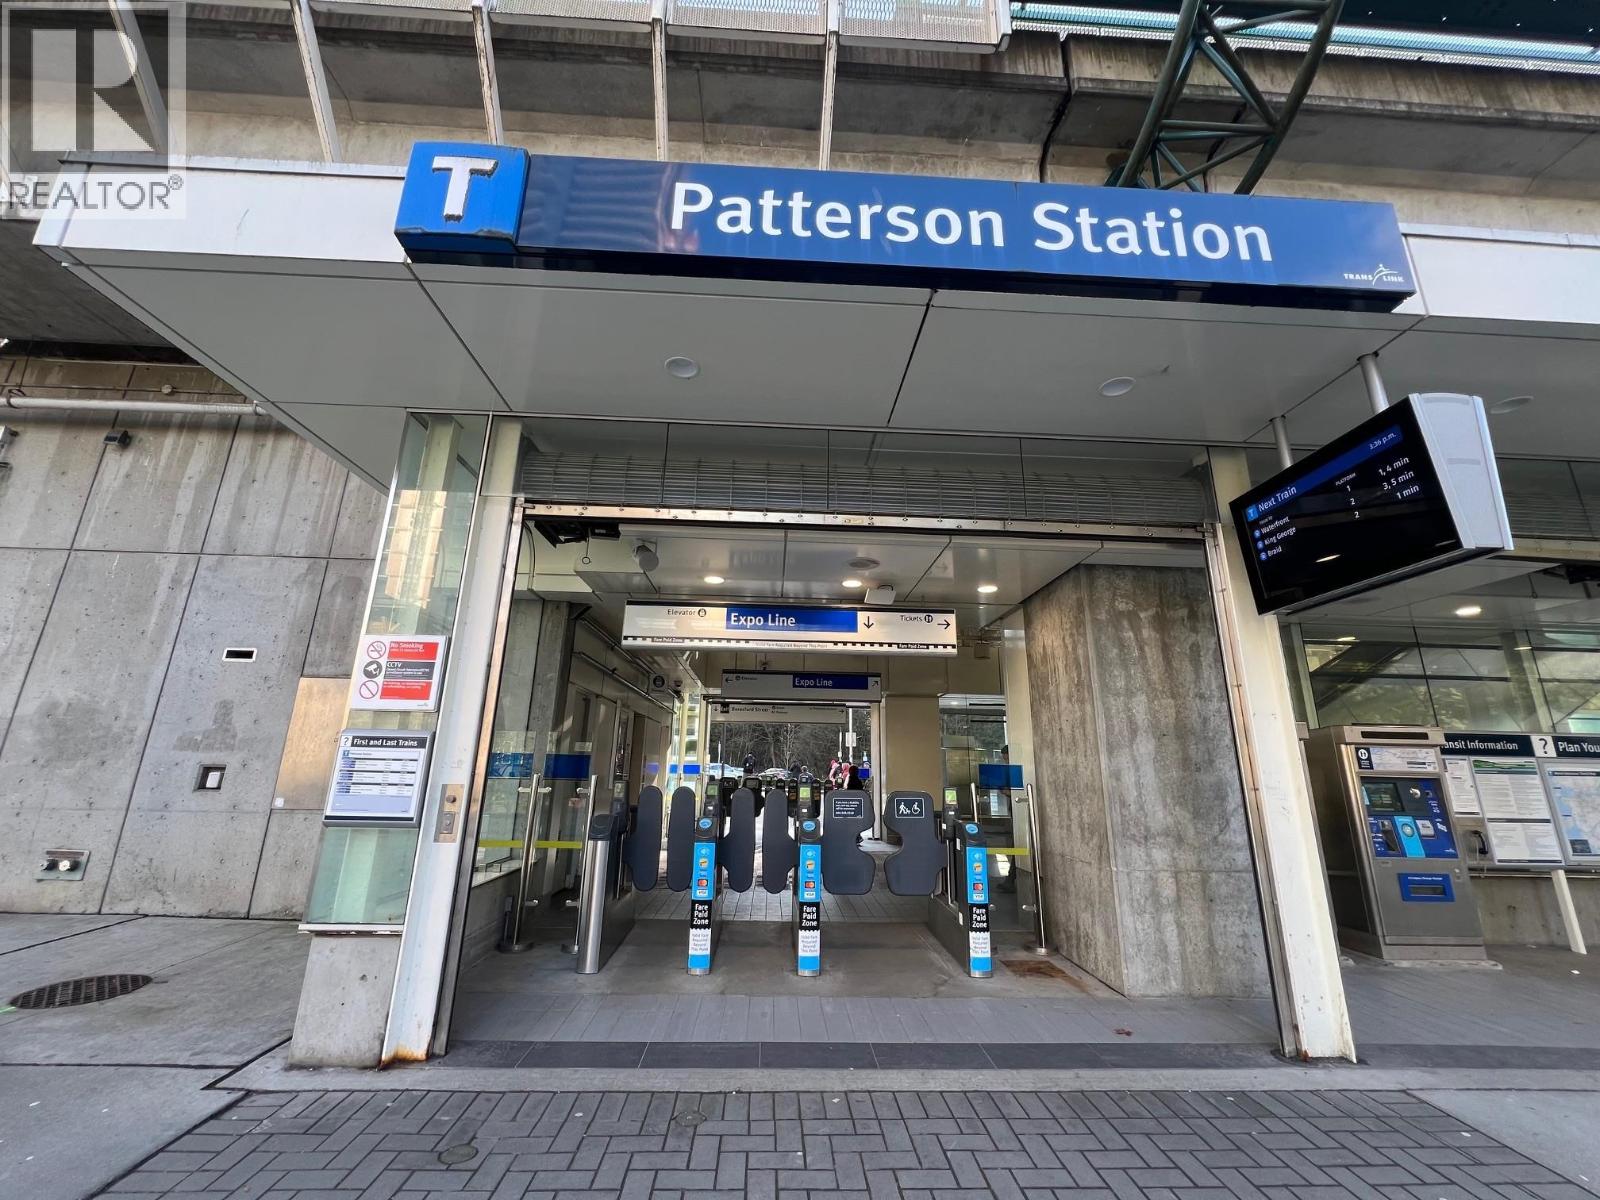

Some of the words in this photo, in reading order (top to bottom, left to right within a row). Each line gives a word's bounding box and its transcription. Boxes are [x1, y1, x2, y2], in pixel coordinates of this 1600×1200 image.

[432, 156, 499, 222] T
[671, 181, 1005, 247] Patterson
[1033, 202, 1273, 262] Station
[1258, 497, 1276, 512] Next
[1275, 486, 1297, 502] Train
[1260, 516, 1290, 534] Waterfront
[1393, 457, 1410, 469] min
[1264, 535, 1278, 545] King
[1276, 527, 1297, 540] George
[1350, 497, 1356, 506] 2
[1382, 482, 1391, 490] 3,
[1390, 478, 1397, 487] 5
[1397, 470, 1415, 483] min
[1267, 545, 1283, 557] Braid
[1354, 511, 1360, 519] 2
[1402, 485, 1420, 497] min
[667, 608, 696, 616] Elevator
[730, 612, 764, 629] Expo
[768, 613, 796, 627] Line
[900, 614, 923, 623] Tickets
[795, 677, 815, 688] Expo
[816, 678, 833, 687] Line
[397, 739, 418, 747] Trains
[1466, 739, 1519, 750] Information
[1557, 741, 1581, 752] Plan
[694, 903, 709, 911] Fare
[693, 910, 709, 918] Paid
[802, 912, 817, 920] Paid
[972, 913, 987, 921] Paid
[692, 917, 709, 925] Zone
[801, 919, 818, 927] Zone
[972, 920, 988, 928] Zone
